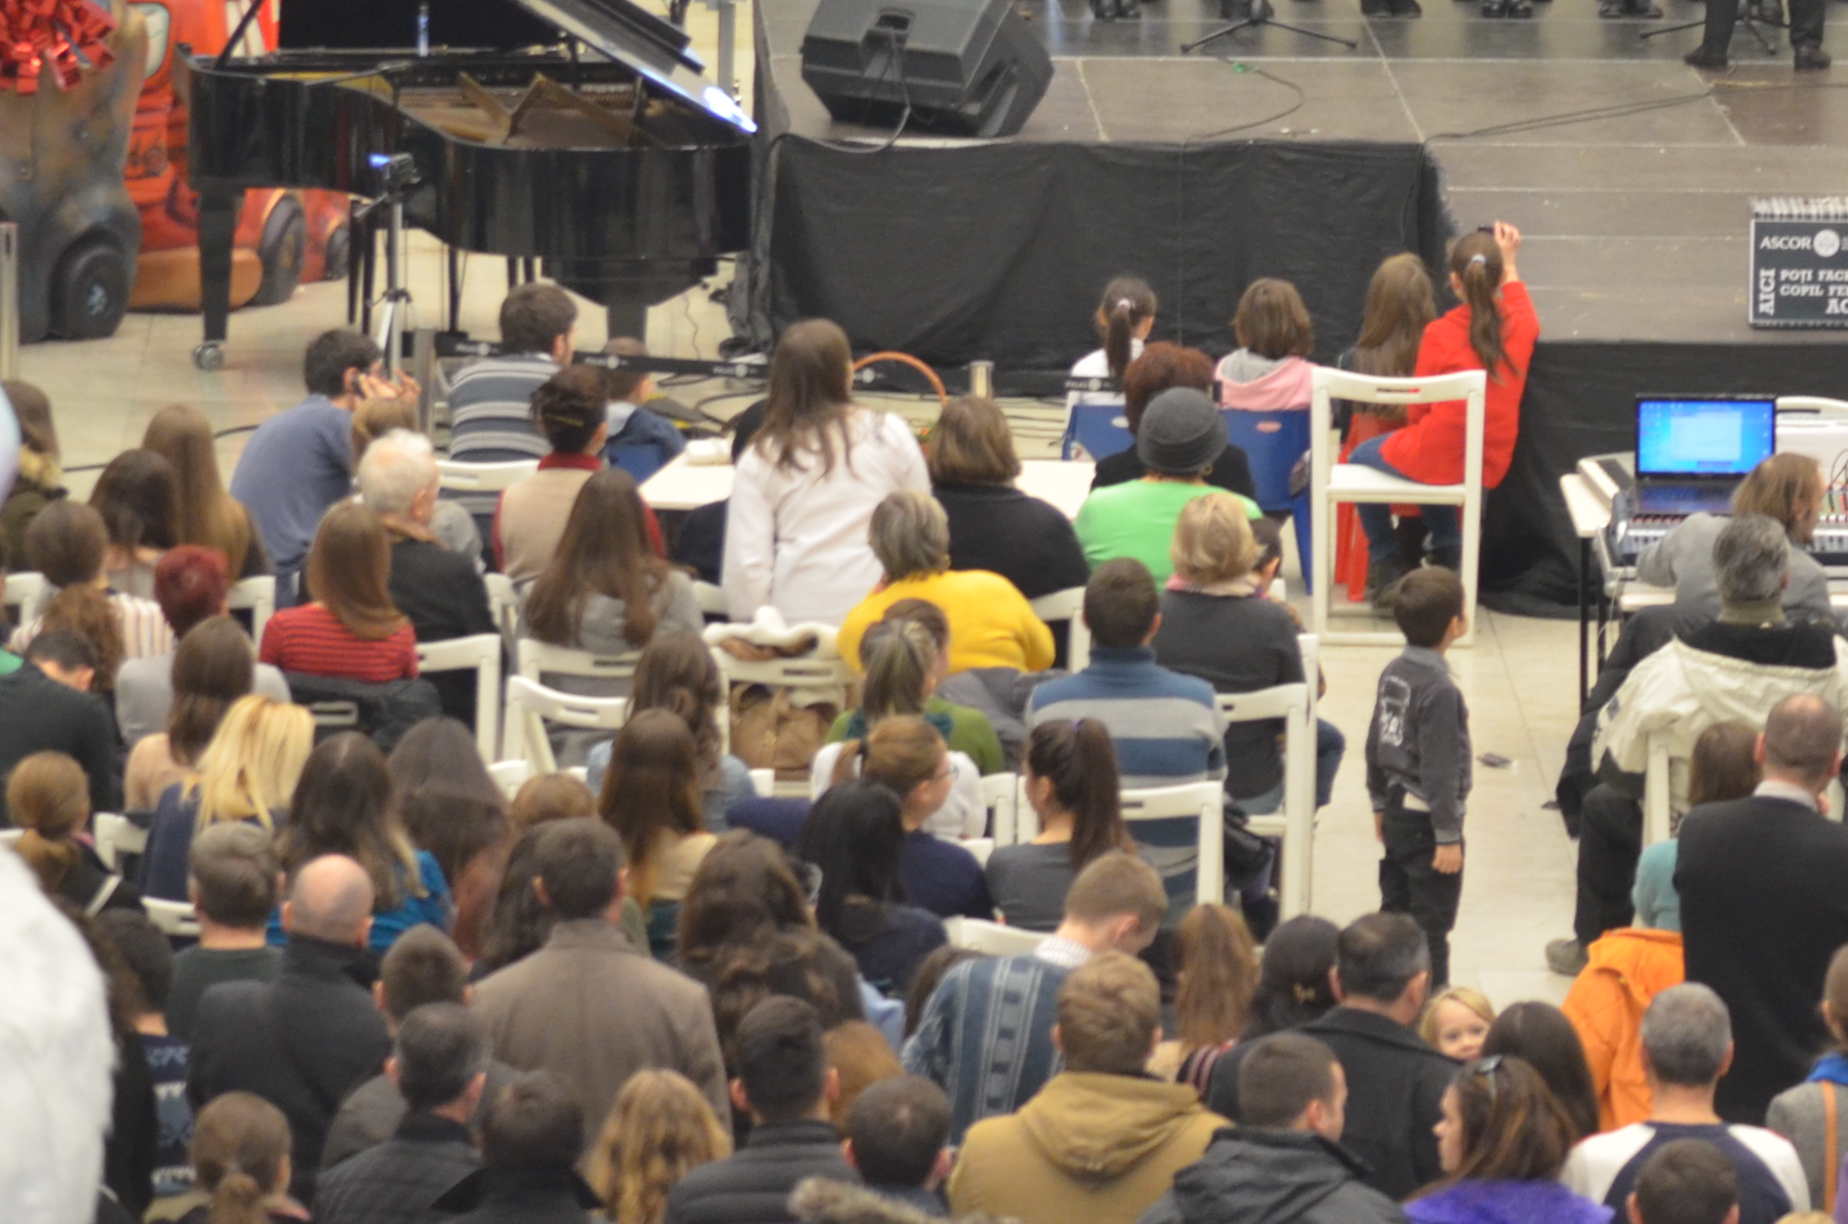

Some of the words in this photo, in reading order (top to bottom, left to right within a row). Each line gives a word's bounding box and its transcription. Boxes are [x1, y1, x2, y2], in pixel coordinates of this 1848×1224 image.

[1759, 236, 1813, 250] ASCOR
[1759, 268, 1776, 316] AICI
[1779, 284, 1824, 297] COPIL
